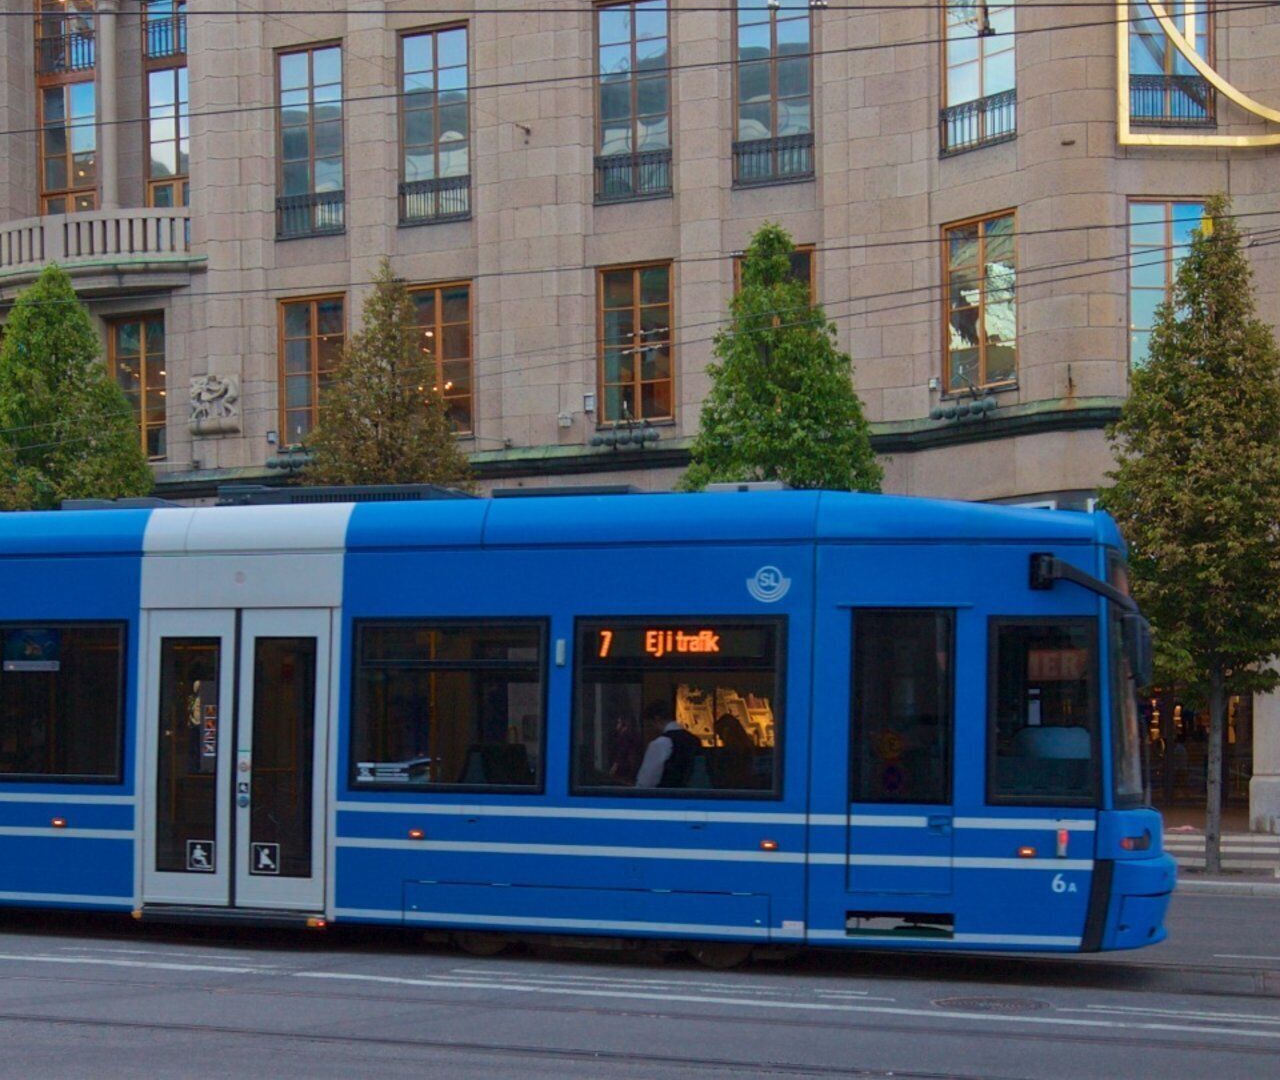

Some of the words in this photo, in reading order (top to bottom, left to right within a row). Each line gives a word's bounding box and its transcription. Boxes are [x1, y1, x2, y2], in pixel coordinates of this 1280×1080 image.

[599, 630, 613, 658] 7
[646, 631, 664, 657] Ej
[666, 631, 673, 652] i
[1051, 873, 1078, 893] 6A
